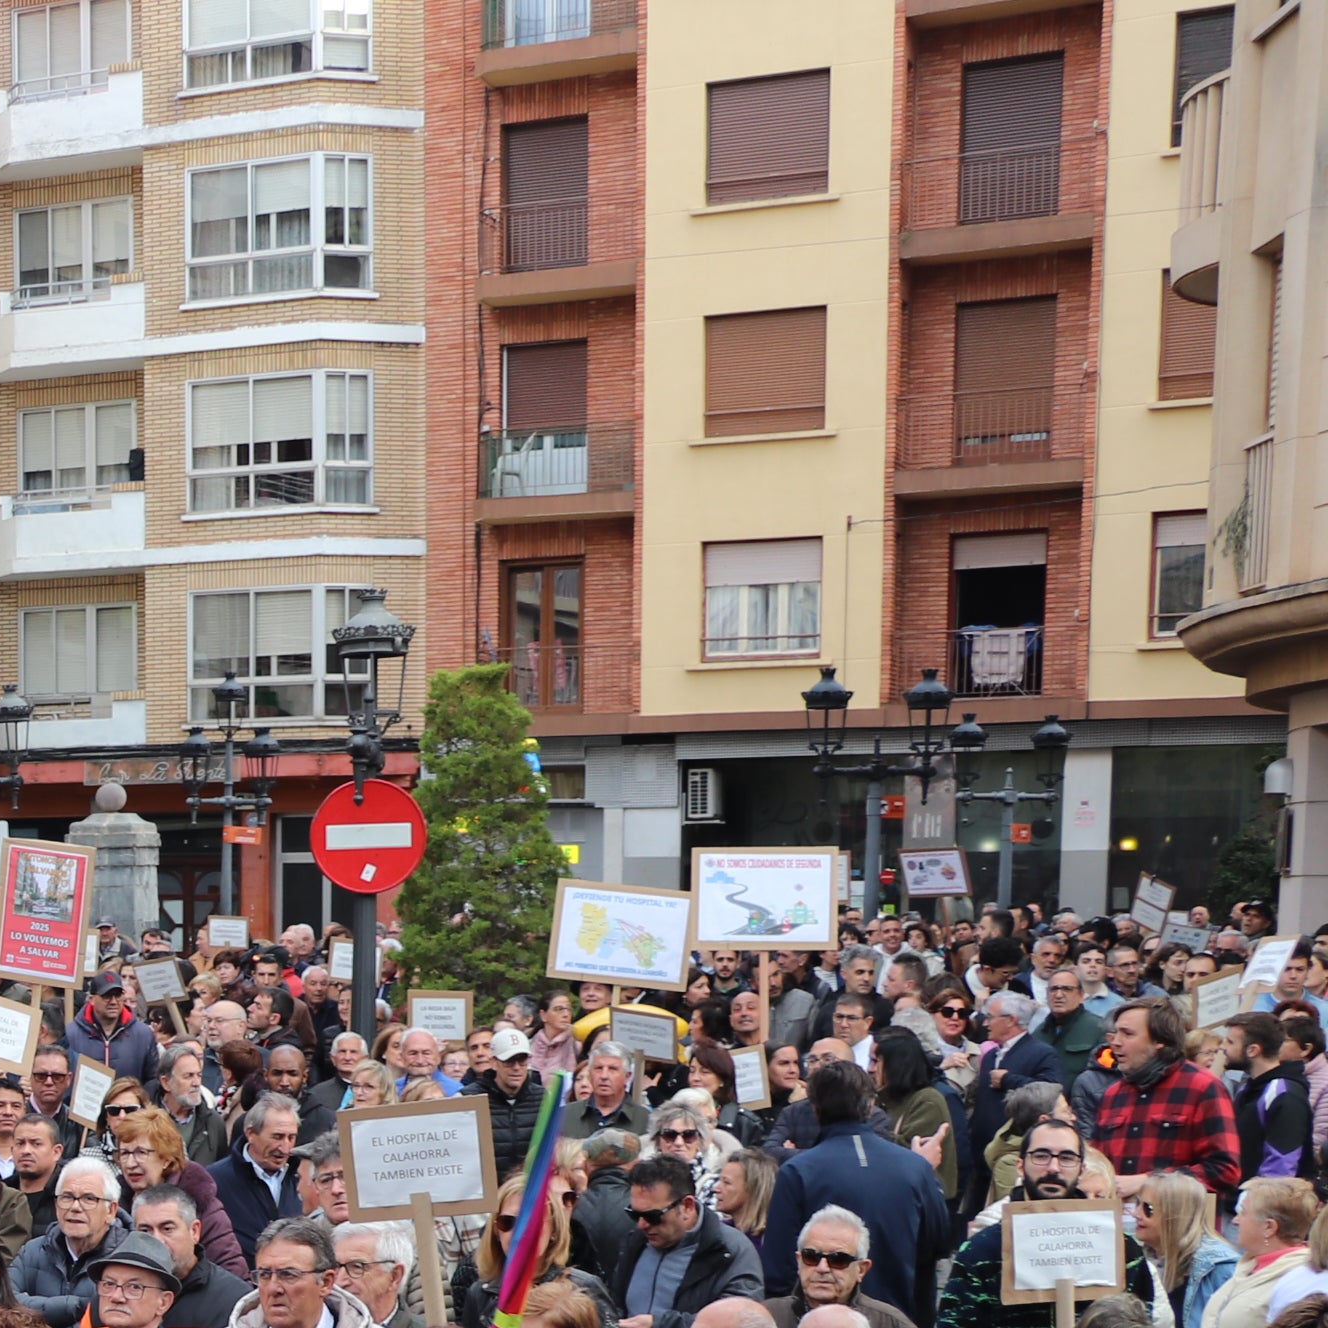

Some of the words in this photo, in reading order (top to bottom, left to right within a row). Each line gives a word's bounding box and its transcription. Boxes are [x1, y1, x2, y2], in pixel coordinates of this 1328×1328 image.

[30, 921, 50, 932] 2025
[11, 931, 22, 940] LO
[24, 933, 69, 948] VOLVEMOS
[20, 945, 27, 954] A
[27, 946, 60, 960] SALVAR
[511, 1034, 520, 1046] B
[371, 1136, 383, 1147] EL
[386, 1132, 440, 1146] HOSPITAL
[442, 1129, 458, 1141] DE
[382, 1147, 450, 1163] CALAHORRA
[374, 1166, 422, 1182] TAMBIEN
[422, 1163, 464, 1178] EXISTE
[1029, 1230, 1040, 1238] EL
[1042, 1226, 1086, 1236] HOSPITAL
[1087, 1225, 1101, 1235] DE
[1038, 1241, 1094, 1251] CALAHORRA
[1029, 1257, 1072, 1267] TAMBIEN
[1073, 1255, 1103, 1266] EXISTE
